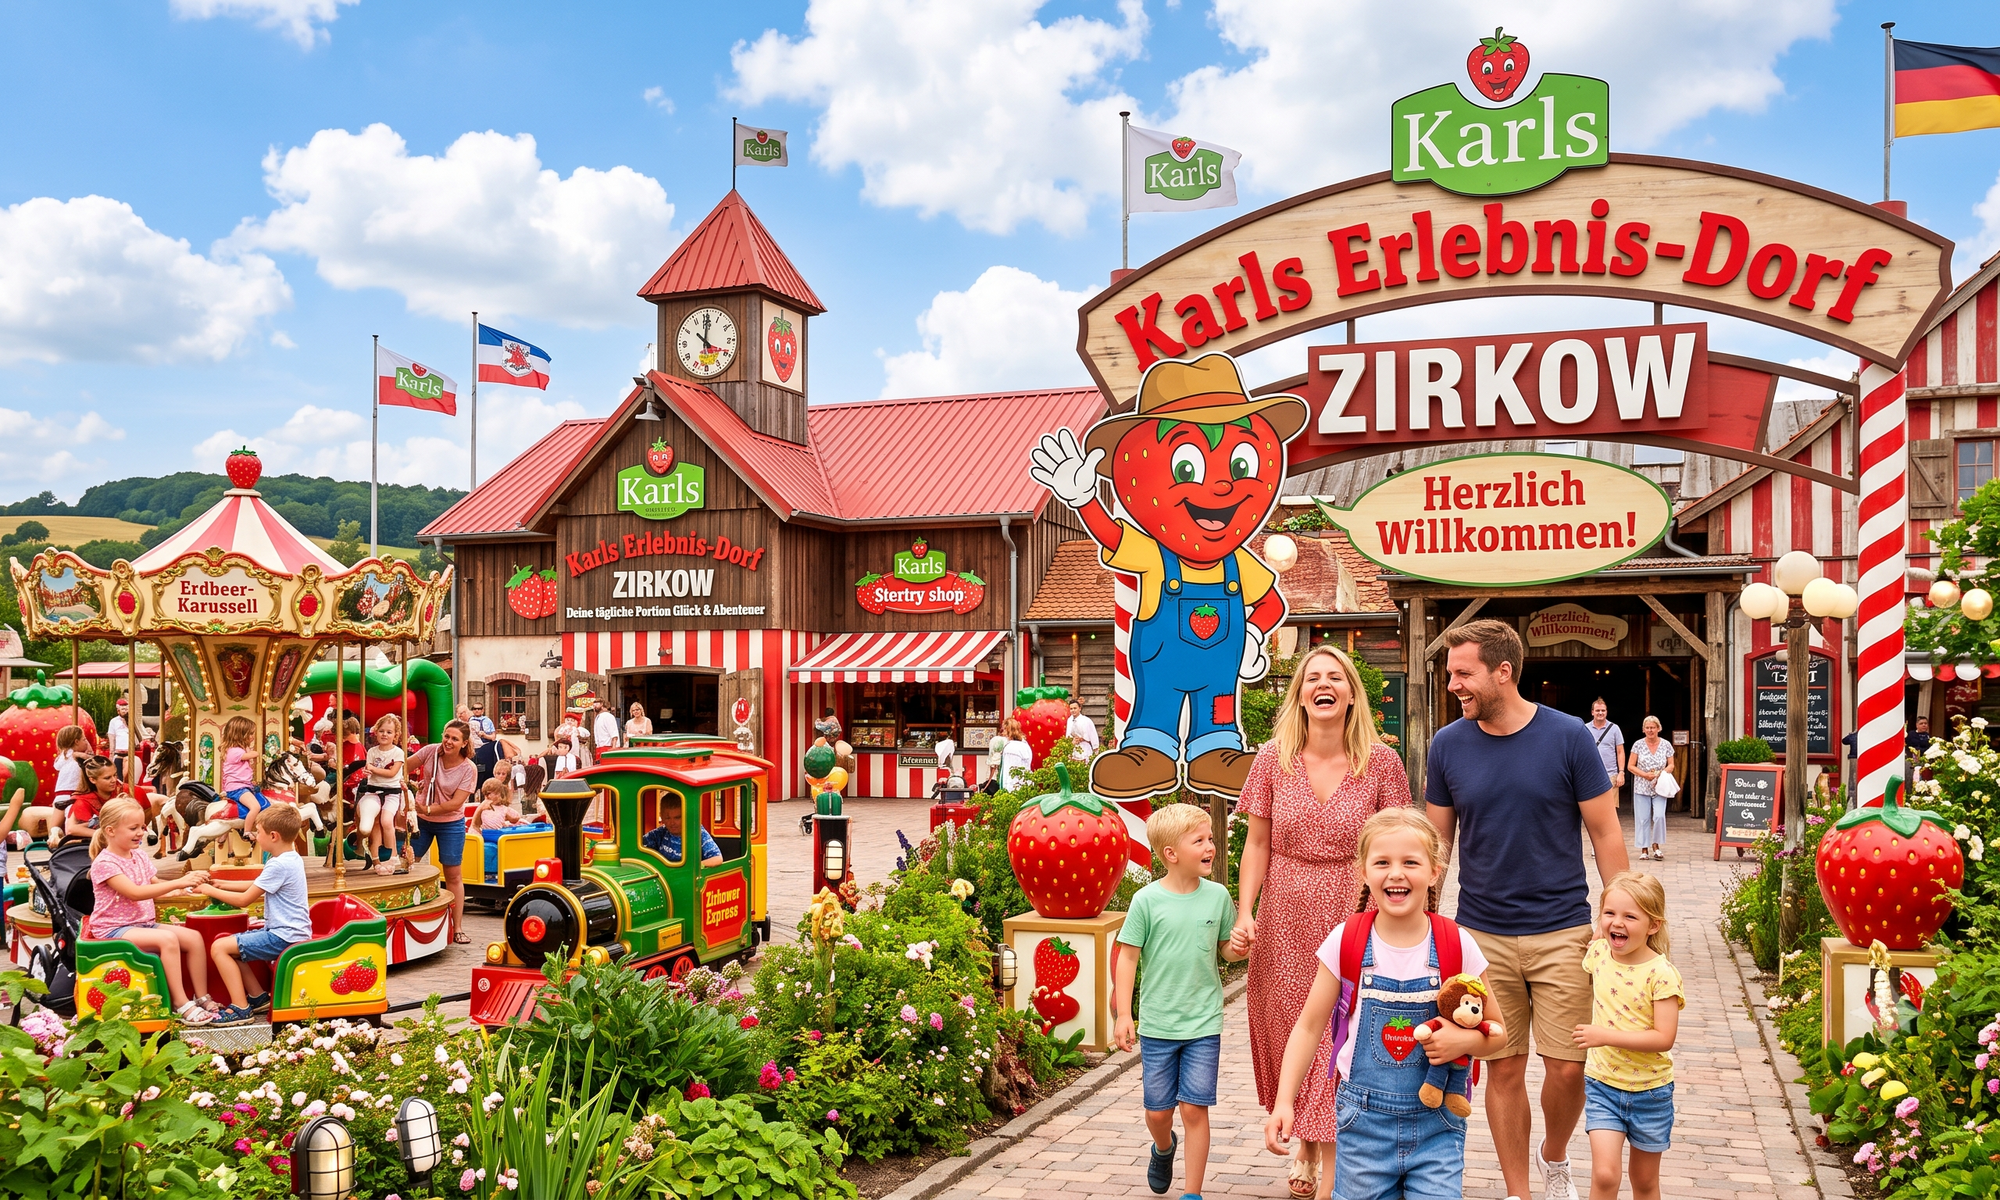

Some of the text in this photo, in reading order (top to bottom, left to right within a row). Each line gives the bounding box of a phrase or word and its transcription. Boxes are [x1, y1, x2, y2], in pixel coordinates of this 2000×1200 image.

[745, 143, 780, 157] Karls
[1401, 96, 1599, 173] Karls
[1149, 156, 1218, 188] Karls
[1114, 198, 1890, 373] Karls Erlebnis-Dorf
[397, 371, 441, 397] Karls
[1317, 332, 1697, 435] ZIRKOW
[621, 473, 700, 506] Karls
[1423, 469, 1586, 511] Herzlich
[1375, 511, 1637, 556] Willkommen!
[565, 530, 765, 578] Karls Erlebnis-Dorf
[897, 557, 943, 575] Karls
[180, 580, 255, 597] Erdbeer-
[612, 568, 715, 599] ZIRKOW
[874, 586, 965, 606] Stertry shop
[177, 597, 259, 614] Karussell
[566, 603, 766, 621] Deine tägliche Portion Glück & Abenteuer
[706, 905, 738, 926] Express
